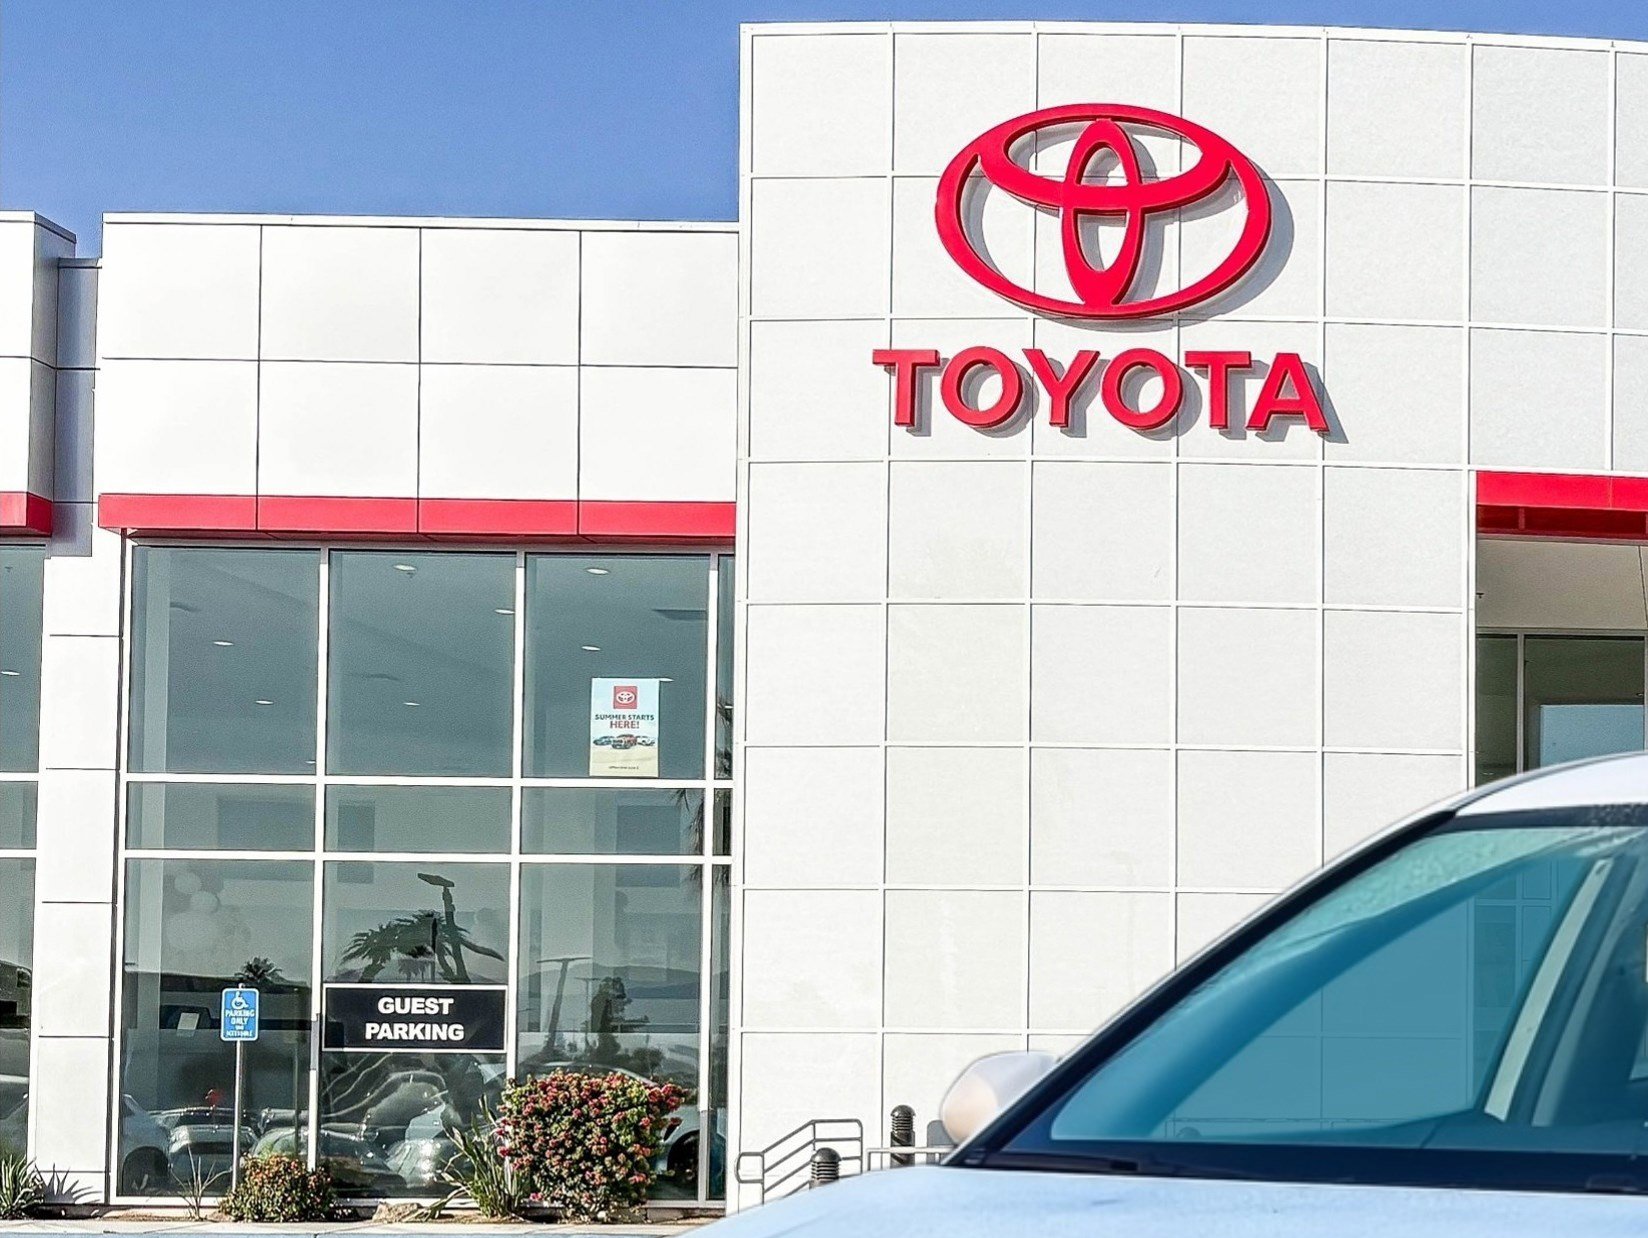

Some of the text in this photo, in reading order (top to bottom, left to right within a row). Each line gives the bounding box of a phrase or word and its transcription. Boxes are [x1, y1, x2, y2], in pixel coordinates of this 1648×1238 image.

[873, 346, 1330, 432] TOYOTA
[610, 721, 640, 729] HERE!
[225, 1009, 255, 1017] PARKING
[377, 997, 454, 1015] GUEST
[365, 1022, 465, 1041] PARKING
